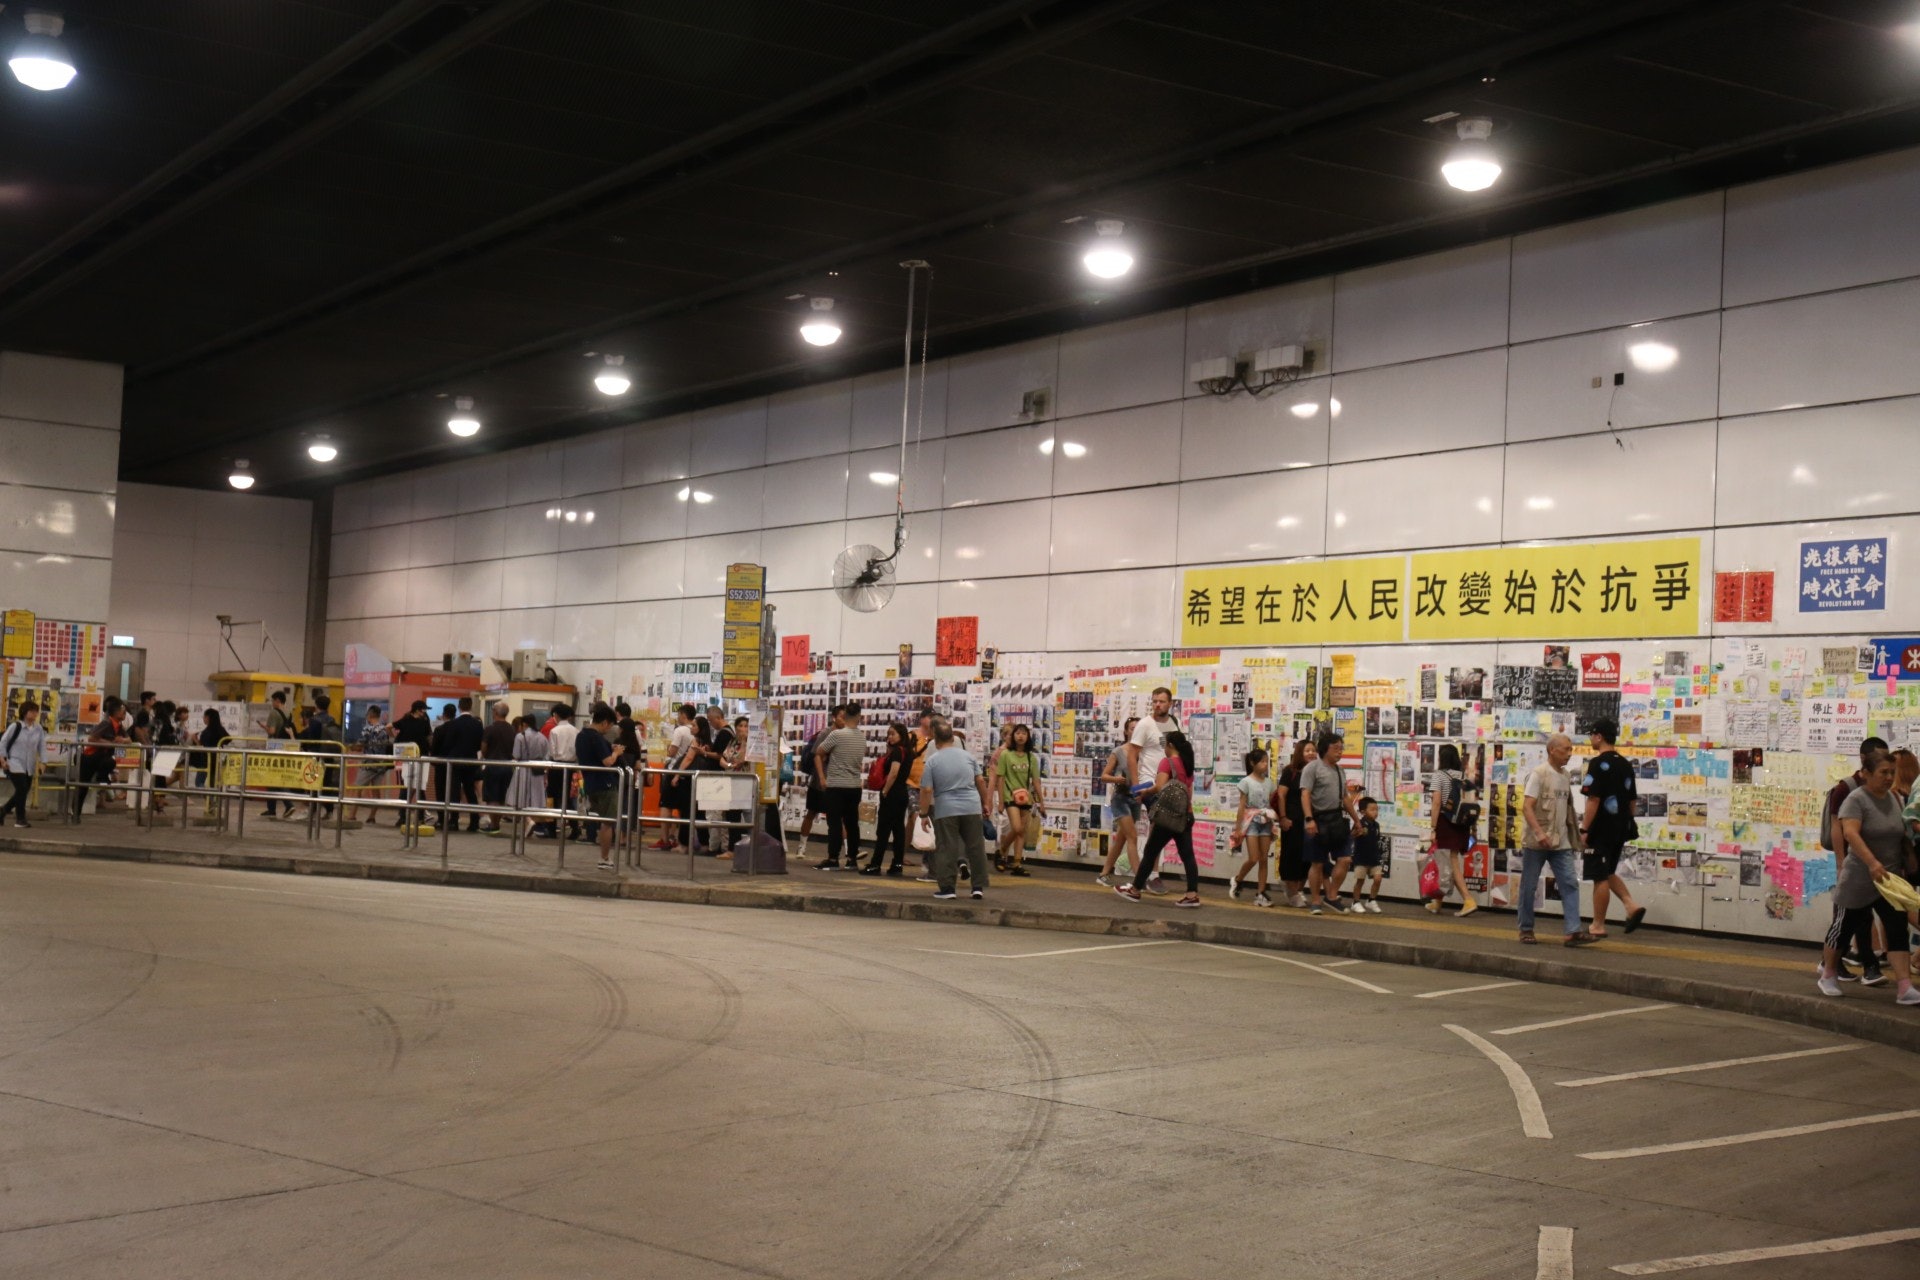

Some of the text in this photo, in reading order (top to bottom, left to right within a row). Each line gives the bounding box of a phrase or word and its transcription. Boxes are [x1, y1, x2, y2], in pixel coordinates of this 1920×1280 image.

[1803, 543, 1883, 568] 光復香港
[1820, 568, 1833, 576] FREE
[1187, 578, 1399, 627] 希望在於人民
[1415, 560, 1691, 617] 改變始於抗爭
[1802, 573, 1884, 601] 時代革命
[729, 589, 743, 600] S52
[1818, 599, 1866, 608] REVOLUTION NOW
[786, 640, 806, 657] TVB
[1812, 703, 1858, 715] 停止 暴力
